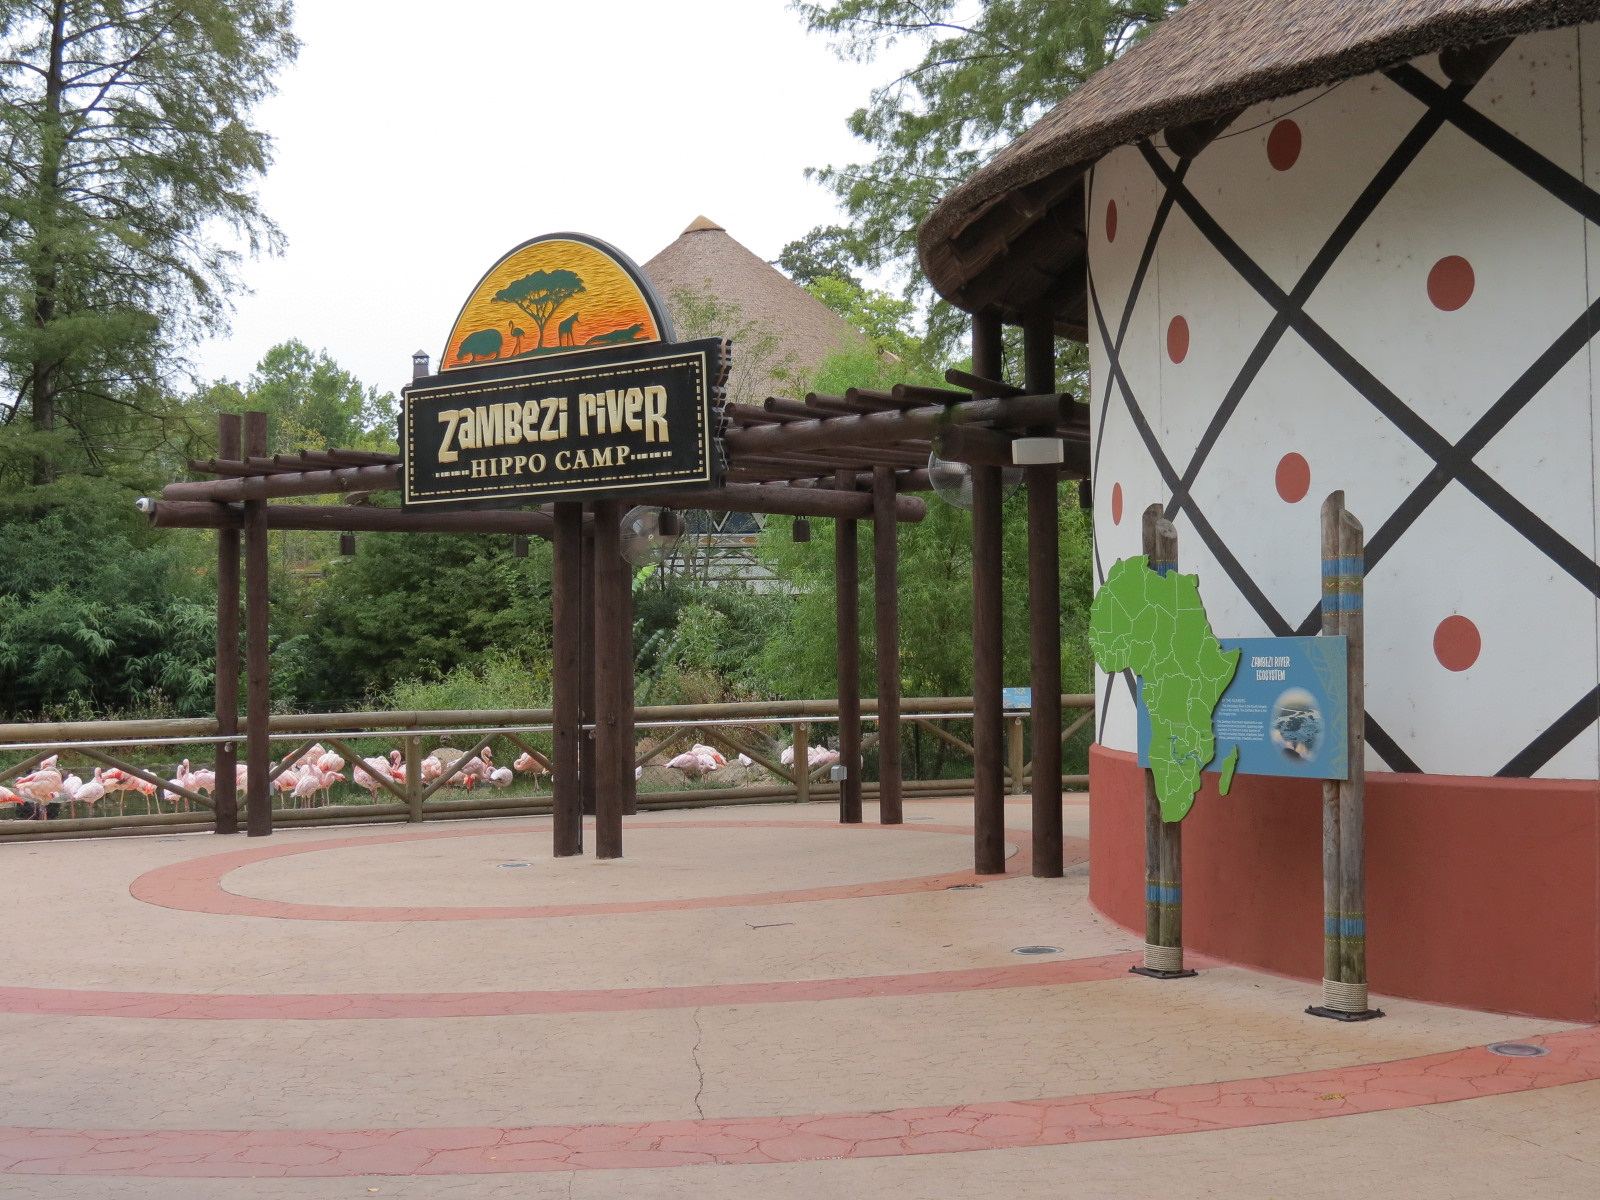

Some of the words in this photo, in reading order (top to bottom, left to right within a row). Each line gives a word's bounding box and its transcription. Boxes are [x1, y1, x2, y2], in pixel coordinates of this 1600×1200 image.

[470, 454, 547, 479] HIPPO
[555, 445, 631, 471] CAMP
[1252, 656, 1274, 667] ZAMBEZI
[1275, 656, 1290, 667] RIVER
[1256, 670, 1286, 681] ECOSYSTEM
